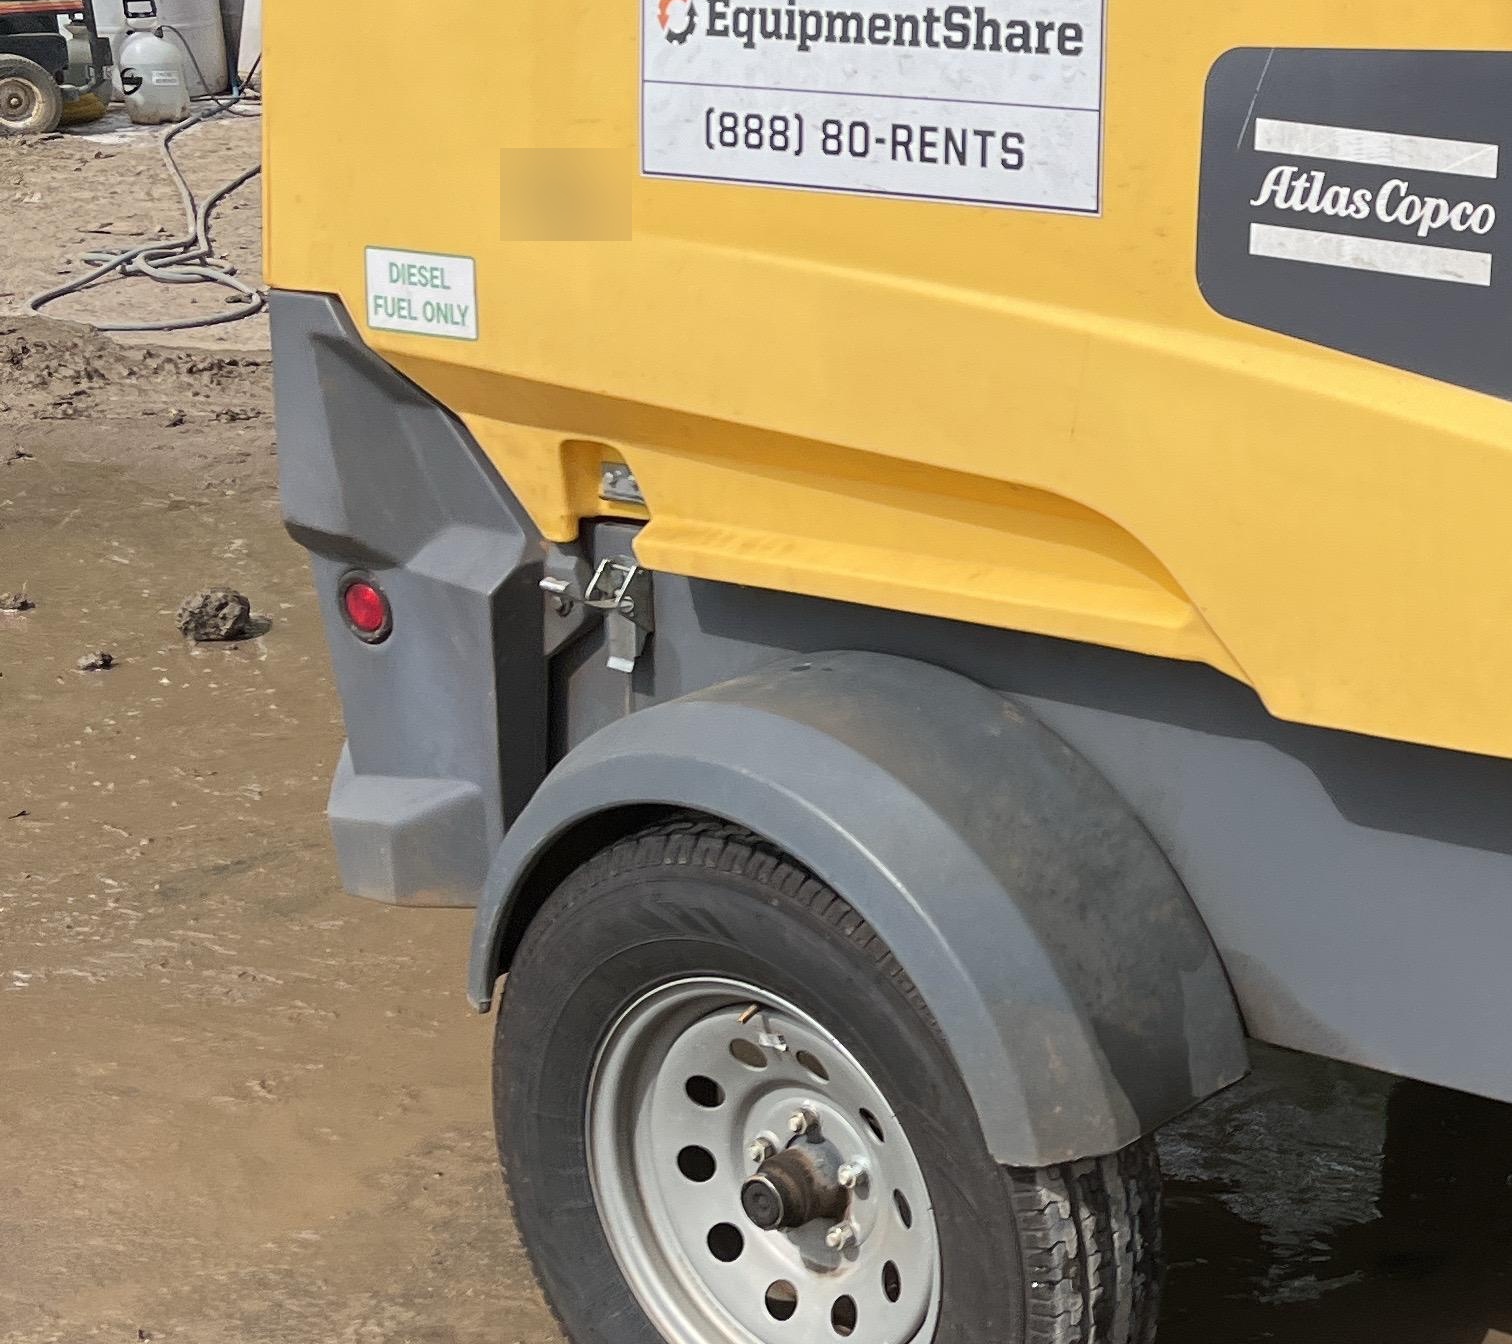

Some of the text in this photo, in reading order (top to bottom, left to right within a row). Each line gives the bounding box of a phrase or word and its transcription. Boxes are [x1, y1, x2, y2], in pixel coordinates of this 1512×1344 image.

[705, 107, 1026, 170] (888) 80-RENTS
[388, 262, 451, 290] DIESEL
[373, 294, 469, 326] FUEL ONLY
